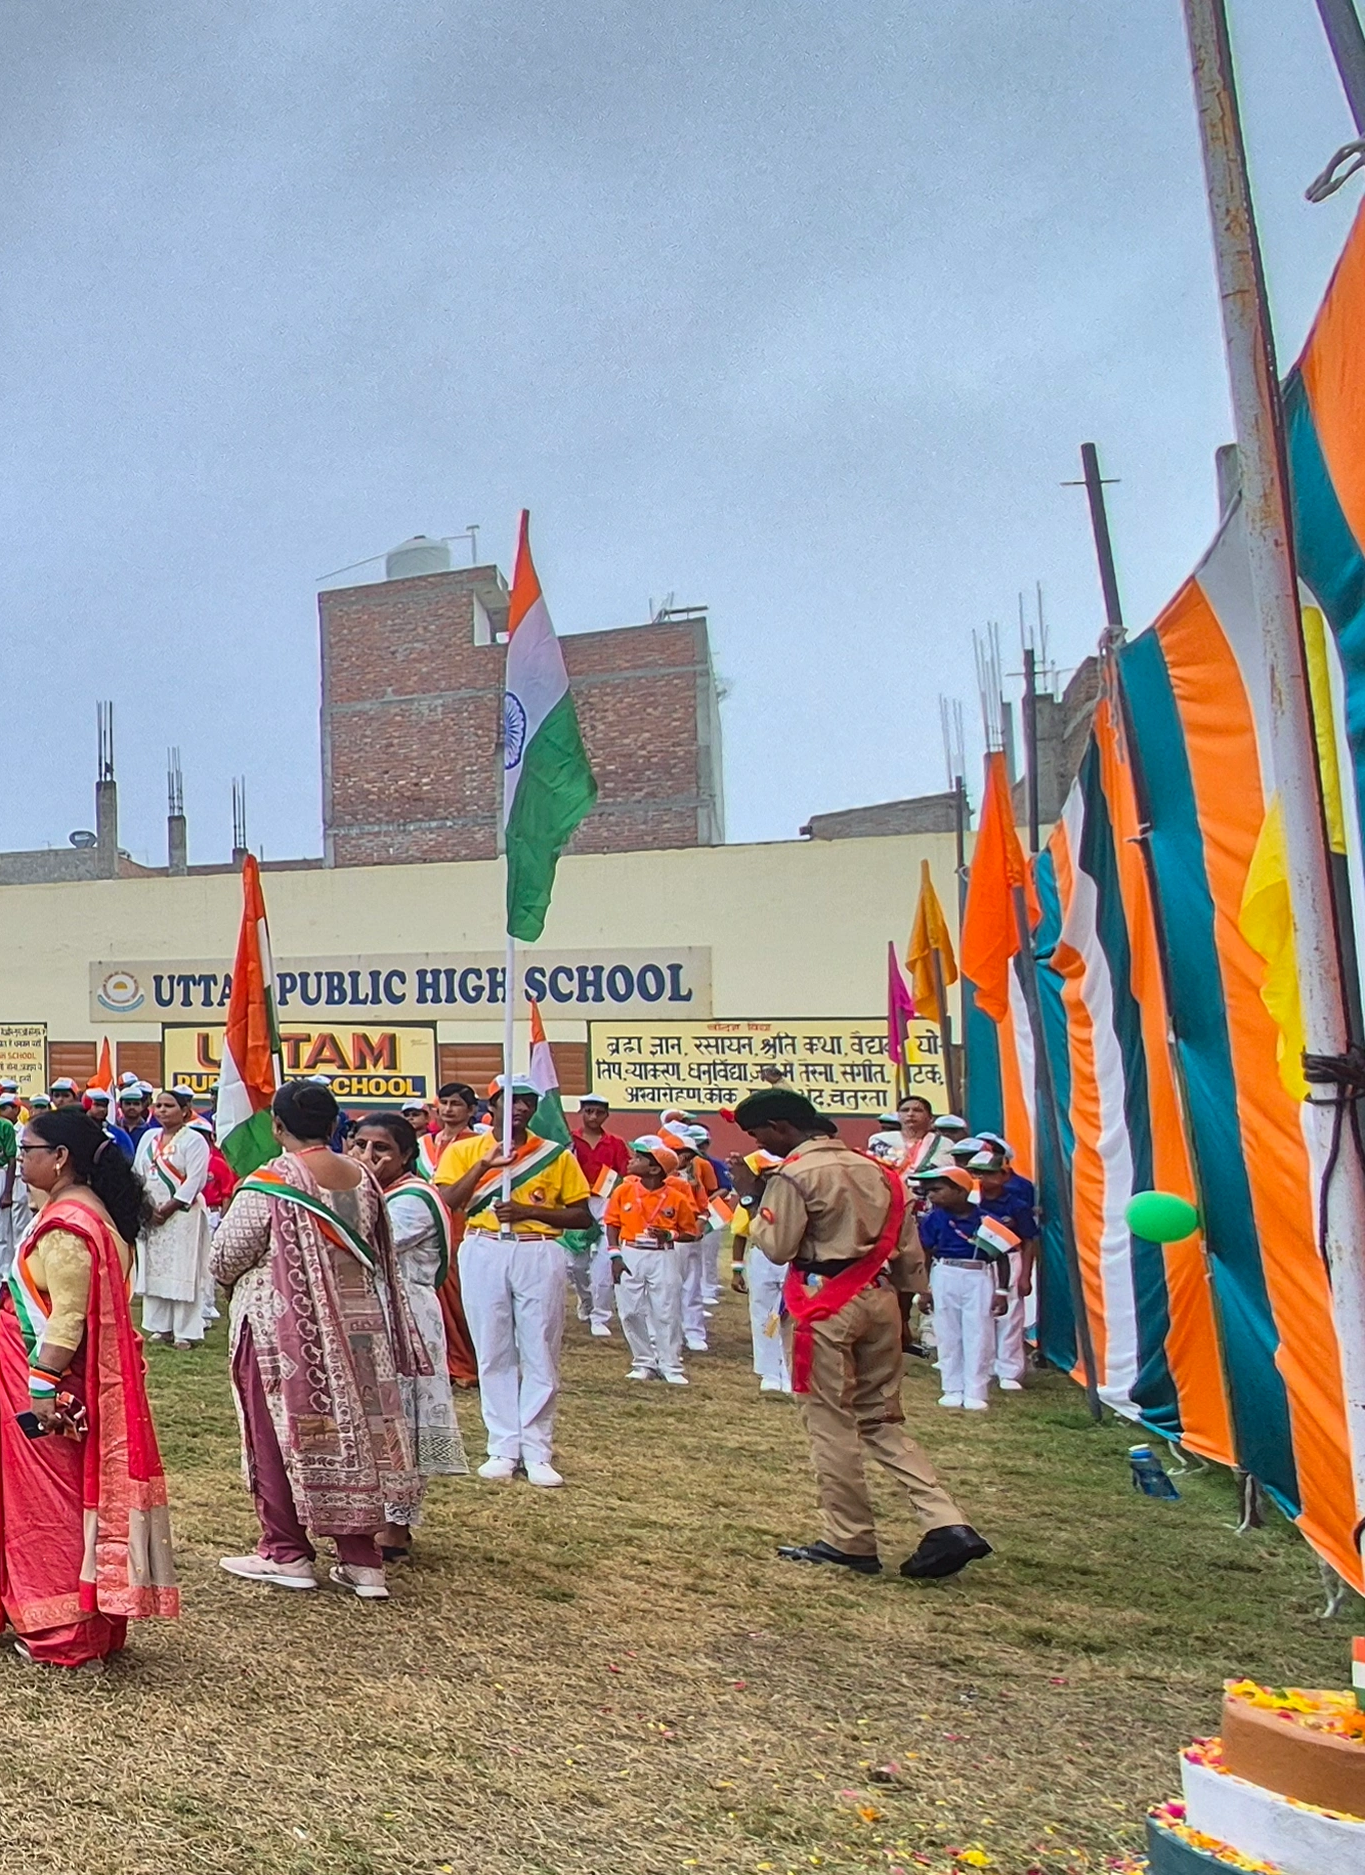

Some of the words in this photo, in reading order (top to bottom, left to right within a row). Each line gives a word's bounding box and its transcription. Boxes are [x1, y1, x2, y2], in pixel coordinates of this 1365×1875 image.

[153, 973, 232, 1008] UTTA
[277, 969, 407, 1007] PUBLIC
[524, 963, 693, 1004] SCHOOL
[7, 1052, 37, 1060] SCHOOL
